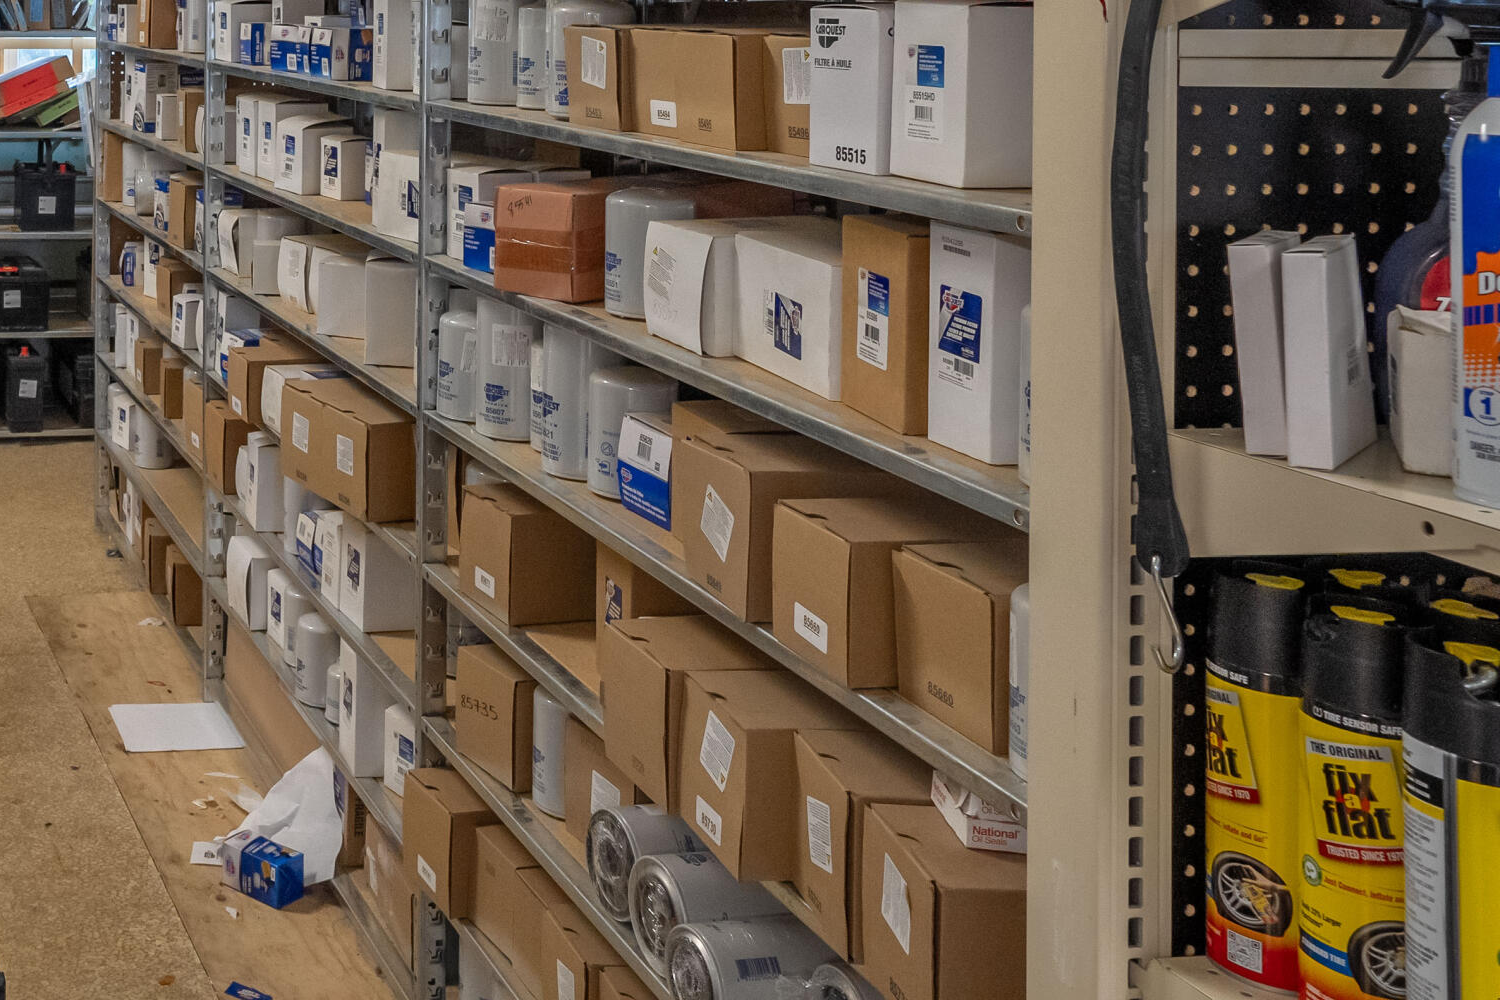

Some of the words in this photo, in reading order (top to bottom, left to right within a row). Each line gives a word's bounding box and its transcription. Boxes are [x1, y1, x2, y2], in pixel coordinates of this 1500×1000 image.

[815, 25, 847, 36] CARQUEST
[814, 58, 830, 67] FILTRE
[912, 90, 936, 102] 85515HD
[787, 126, 810, 139] 85496
[835, 145, 867, 165] 85515
[484, 386, 510, 397] CARQUEST
[485, 407, 505, 416] 85607
[1480, 397, 1492, 415] 1
[803, 614, 820, 632] 85660
[927, 681, 954, 707] 85660
[460, 695, 499, 721] 85735
[1323, 710, 1341, 727] TIRE
[1343, 715, 1379, 737] SENSOR
[1381, 722, 1402, 741] SAFE
[1310, 740, 1328, 756] THE
[1330, 744, 1384, 762] ORIGINAL
[1322, 763, 1380, 803] fix
[701, 812, 716, 836] 85730
[1321, 802, 1394, 842] flat
[972, 825, 1019, 840] National
[972, 835, 984, 844] Oil
[984, 837, 1008, 847] Seals
[1327, 845, 1360, 862] TRUSTED
[1362, 850, 1386, 865] SINCE
[1330, 952, 1347, 967] TIRE
